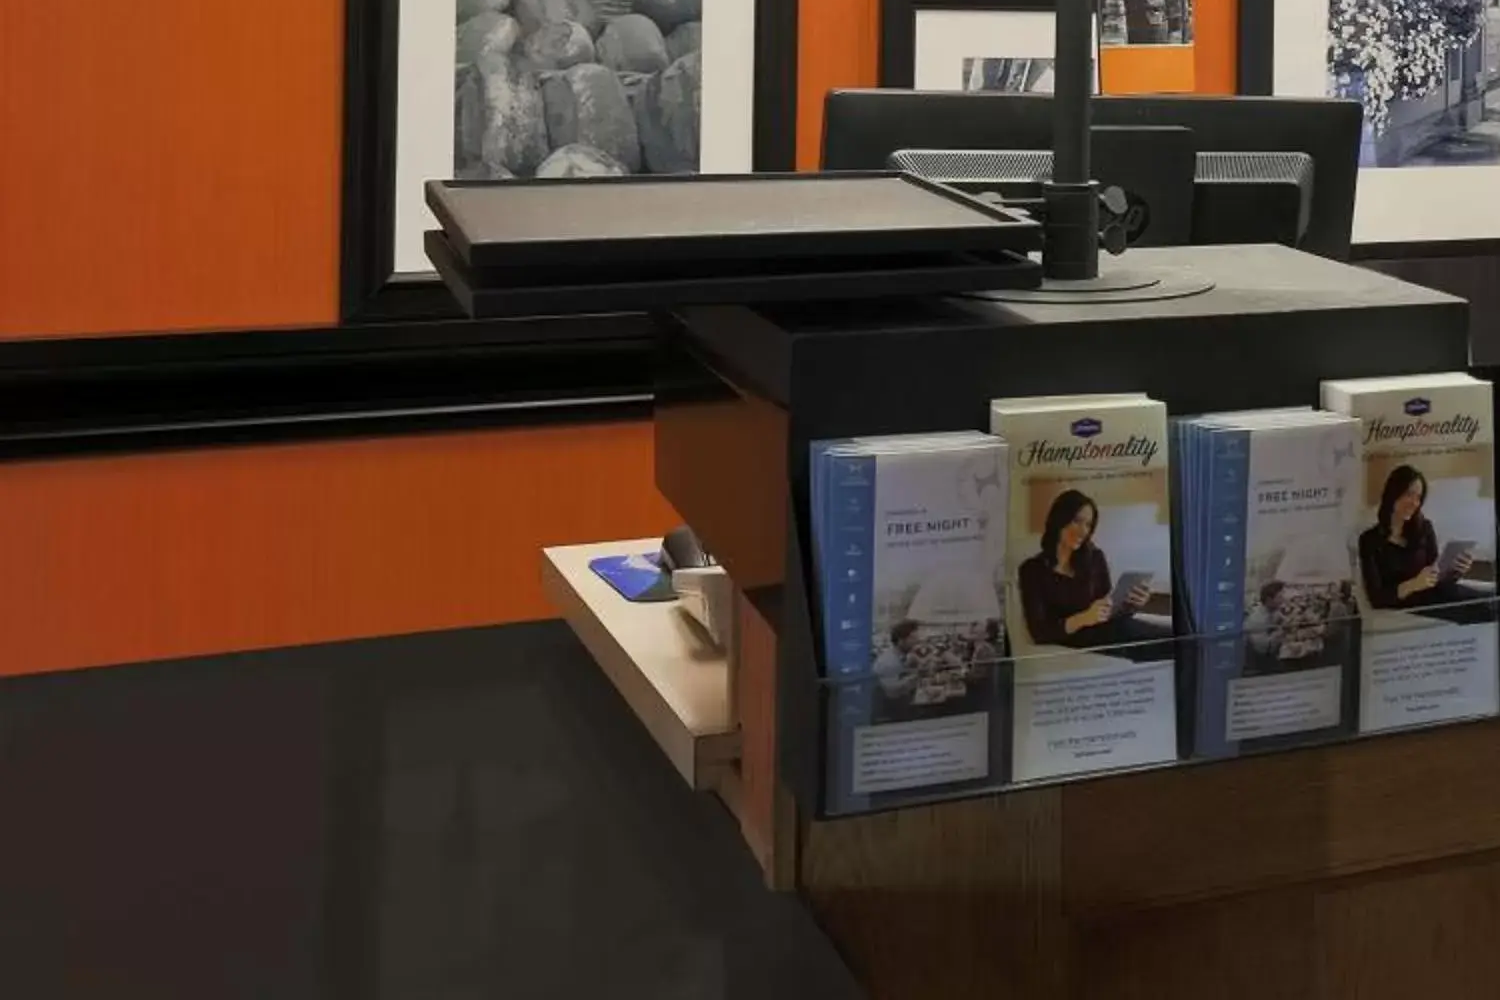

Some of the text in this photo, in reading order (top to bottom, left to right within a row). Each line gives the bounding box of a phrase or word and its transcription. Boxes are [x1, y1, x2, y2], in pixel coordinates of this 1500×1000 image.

[1361, 413, 1481, 446] Hamptonality
[1018, 433, 1158, 467] Hamptonality
[886, 517, 971, 536] FREE NIGHT
